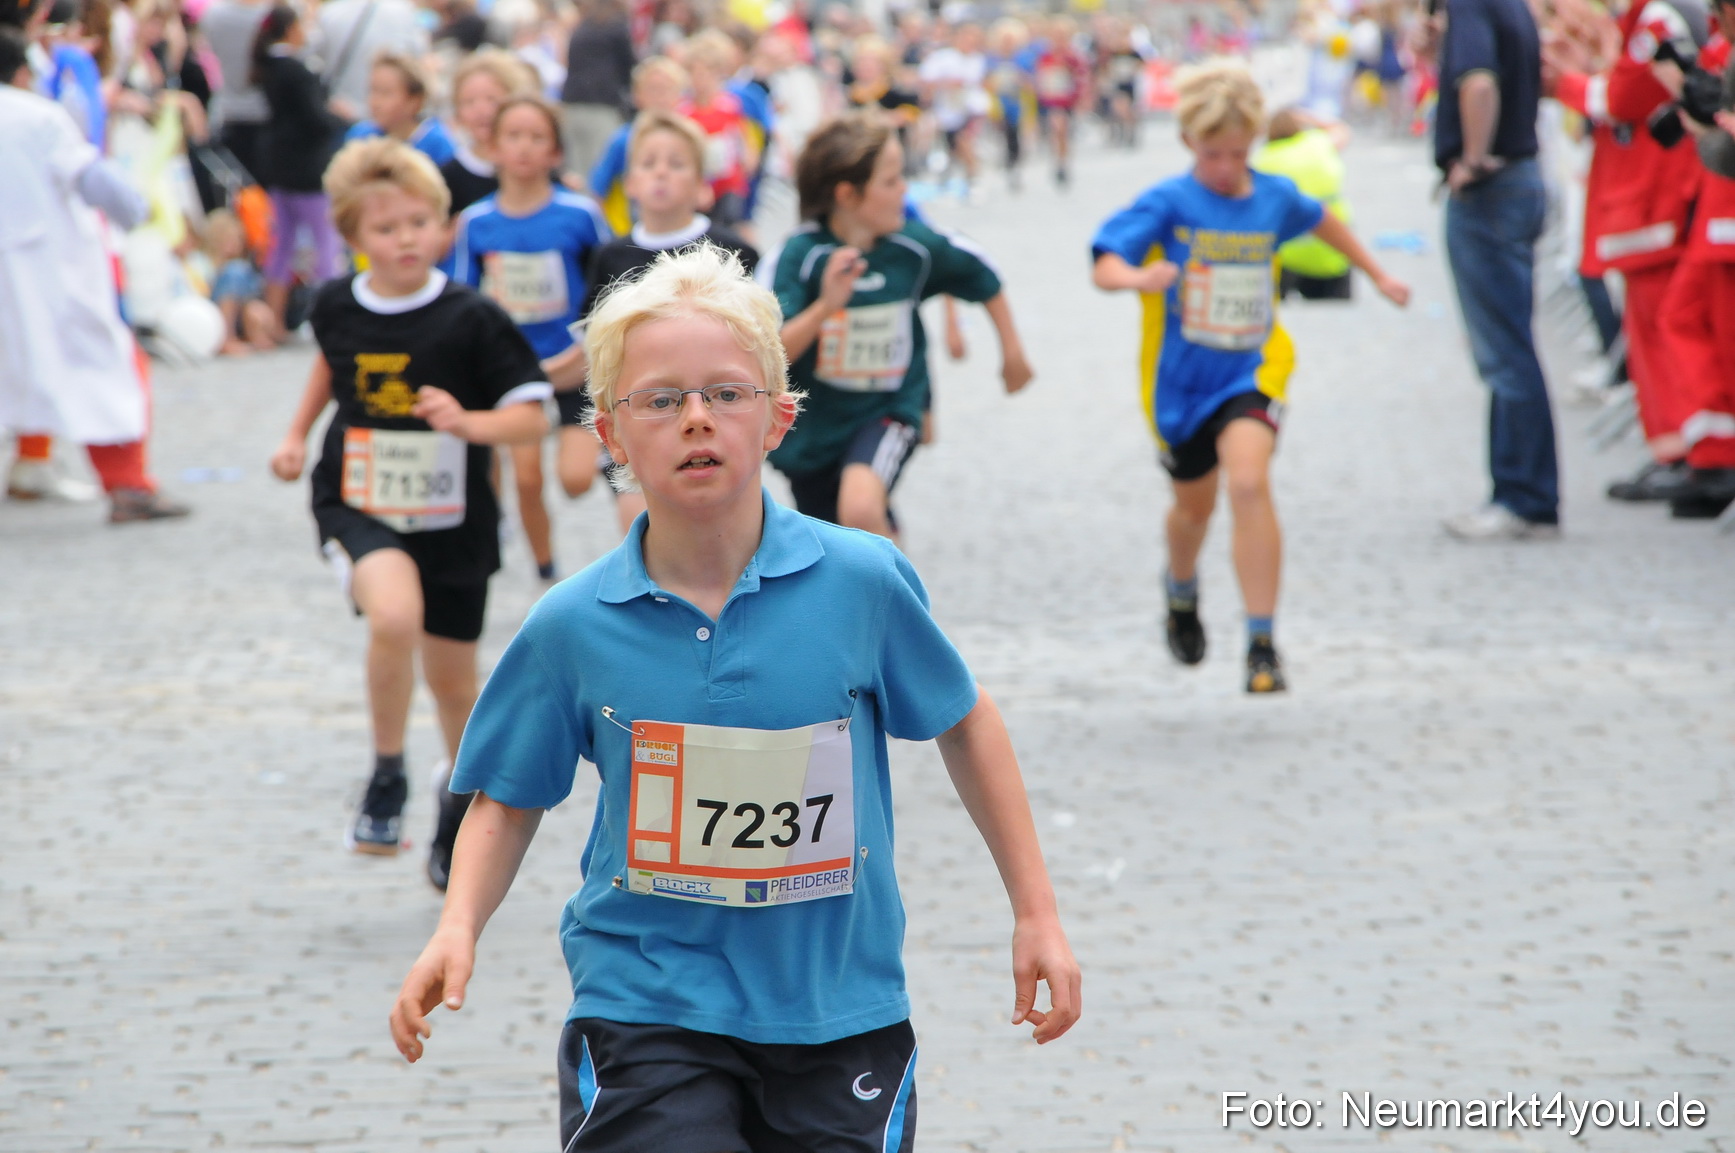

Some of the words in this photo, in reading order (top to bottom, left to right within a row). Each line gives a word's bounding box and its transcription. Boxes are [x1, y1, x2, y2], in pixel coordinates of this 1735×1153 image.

[378, 471, 454, 499] 7130
[696, 793, 834, 849] 7237
[653, 877, 711, 895] BOCK
[770, 869, 849, 893] PFLEIDERER
